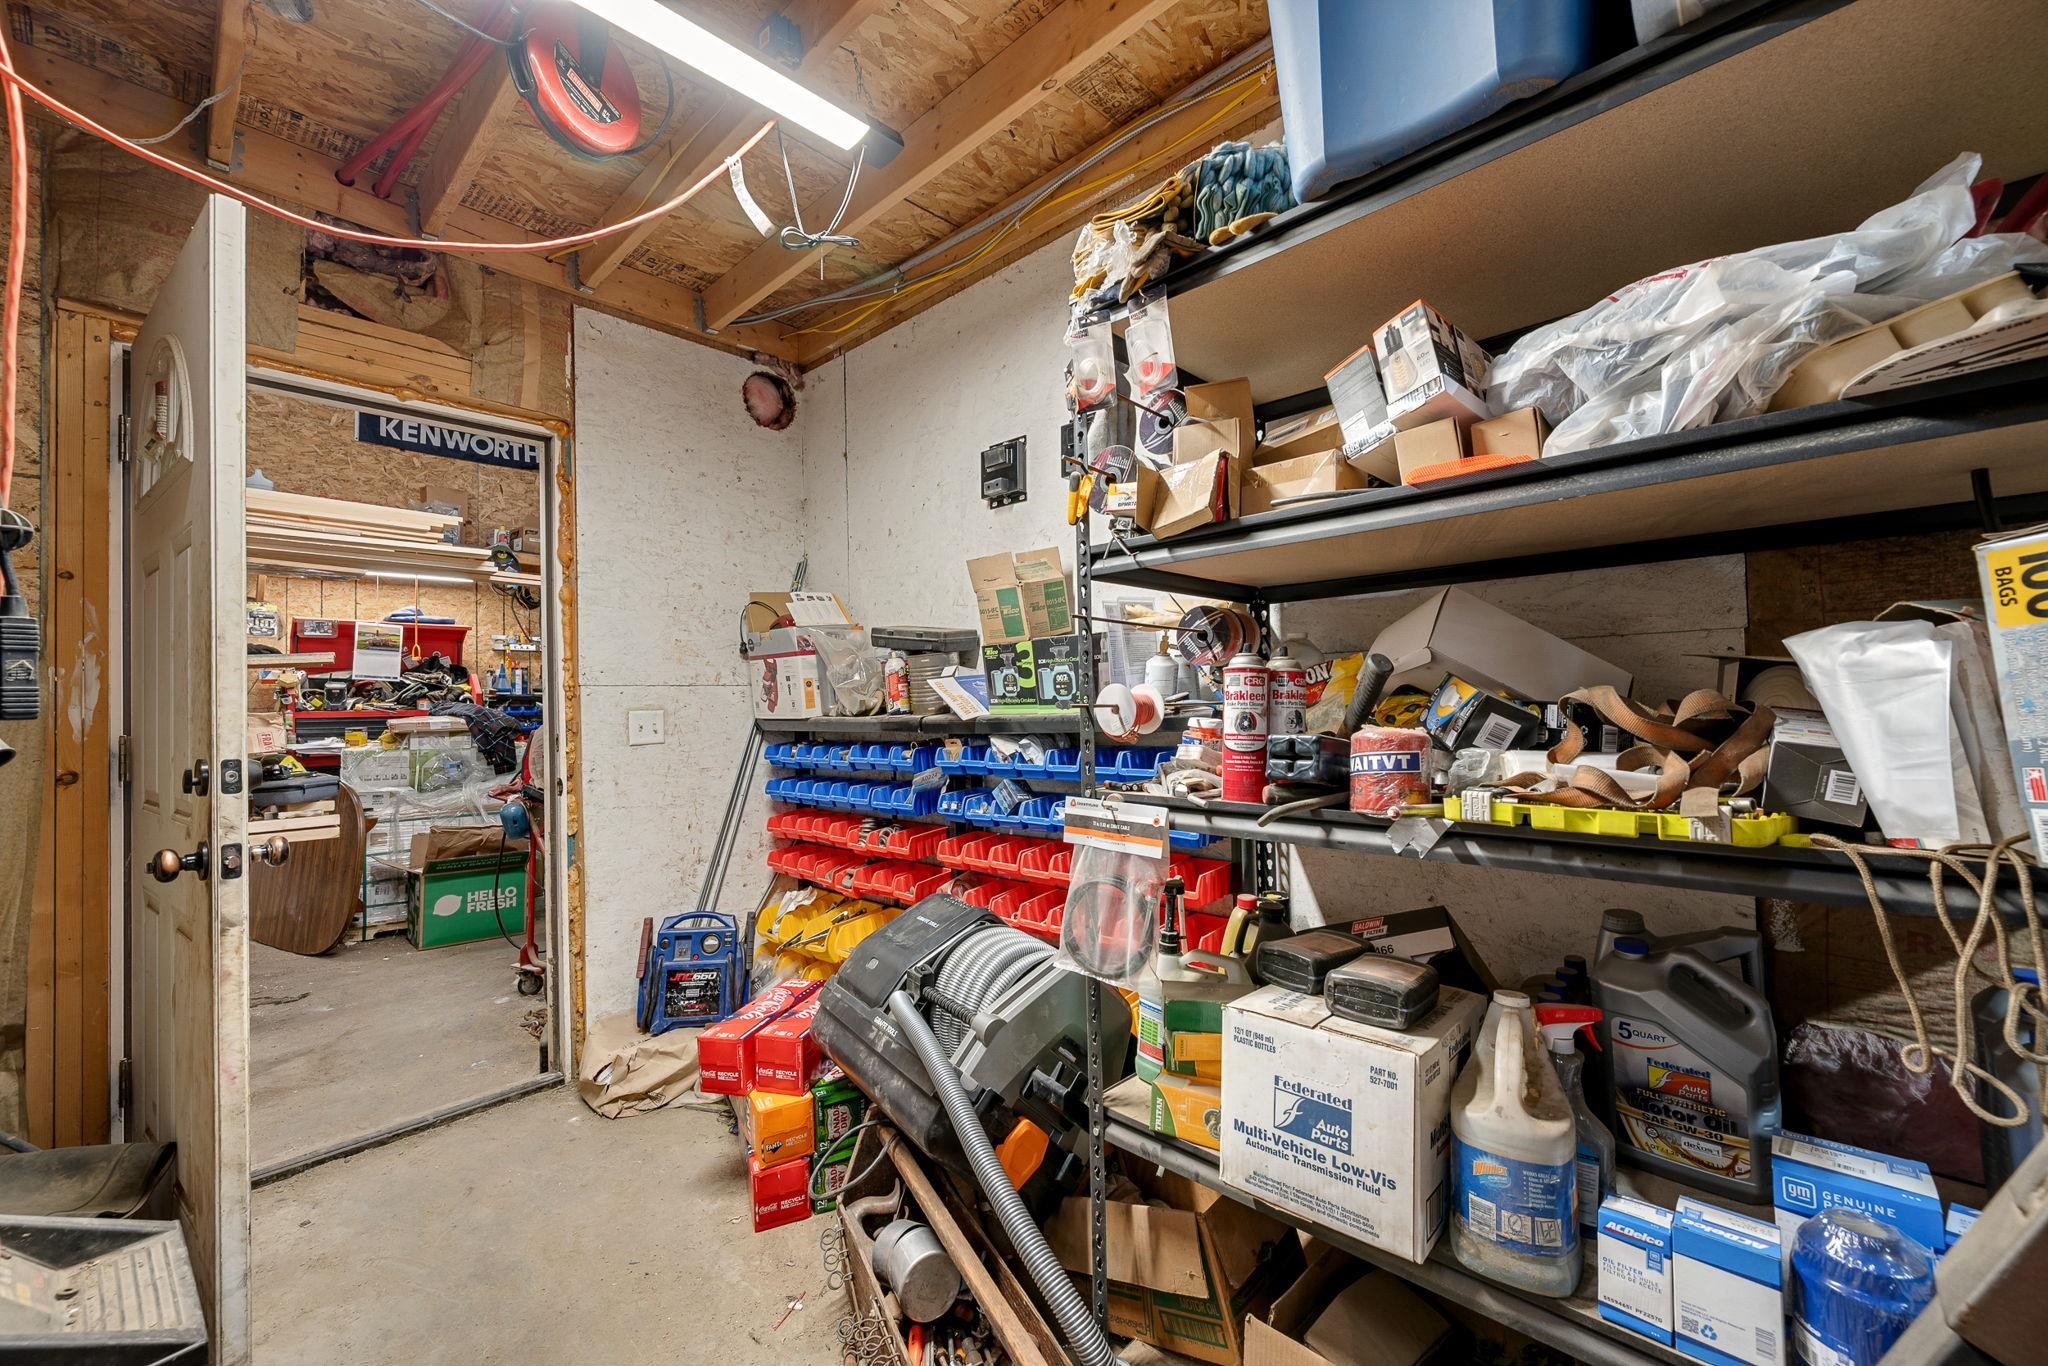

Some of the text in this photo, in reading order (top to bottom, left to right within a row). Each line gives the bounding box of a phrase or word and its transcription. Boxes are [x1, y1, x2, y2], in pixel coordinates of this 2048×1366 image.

[379, 416, 540, 464] KENWORTH
[1995, 566, 2018, 607] BAGS
[1245, 677, 1265, 685] CRC
[1225, 689, 1266, 702] Bräkleen
[467, 886, 517, 904] HELLO
[467, 896, 517, 914] FRESH
[1352, 918, 1382, 933] BALDWIN
[1366, 927, 1386, 937] FILTERS
[1245, 1029, 1252, 1037] QT
[1632, 1029, 1667, 1043] QUART
[1233, 1034, 1276, 1054] PLASTIC BOTTLES
[1370, 1066, 1399, 1081] PART NO.
[1646, 1057, 1712, 1079] Federated
[1274, 1075, 1353, 1111] Federated
[1369, 1076, 1398, 1091] 527-7001
[1681, 1083, 1708, 1095] Auto
[1636, 1087, 1727, 1118] FULL SYNTHETIC
[1678, 1088, 1709, 1102] Parts
[841, 1109, 849, 1130] DRY
[1155, 1097, 1163, 1132] TRITAN
[1630, 1095, 1697, 1126] Motor
[832, 1104, 841, 1139] CANADA
[1315, 1119, 1349, 1139] Auto
[1641, 1112, 1724, 1142] SAE 5W-30
[1311, 1127, 1349, 1151] Parts
[1233, 1118, 1397, 1190] Multi-Vehicle Low-Vis
[1245, 1137, 1381, 1197] Automatic Transmission Fluid
[780, 1194, 806, 1207] RECYCLE
[1787, 1182, 1812, 1200] gm
[817, 1199, 826, 1210] 12
[1822, 1190, 1897, 1219] GENUINE
[1604, 1221, 1665, 1247] ACDelco
[1680, 1218, 1772, 1250] ACDelco
[1602, 1256, 1643, 1276] OIL FILTER
[1602, 1267, 1663, 1294] FILTRO DE ACEITE
